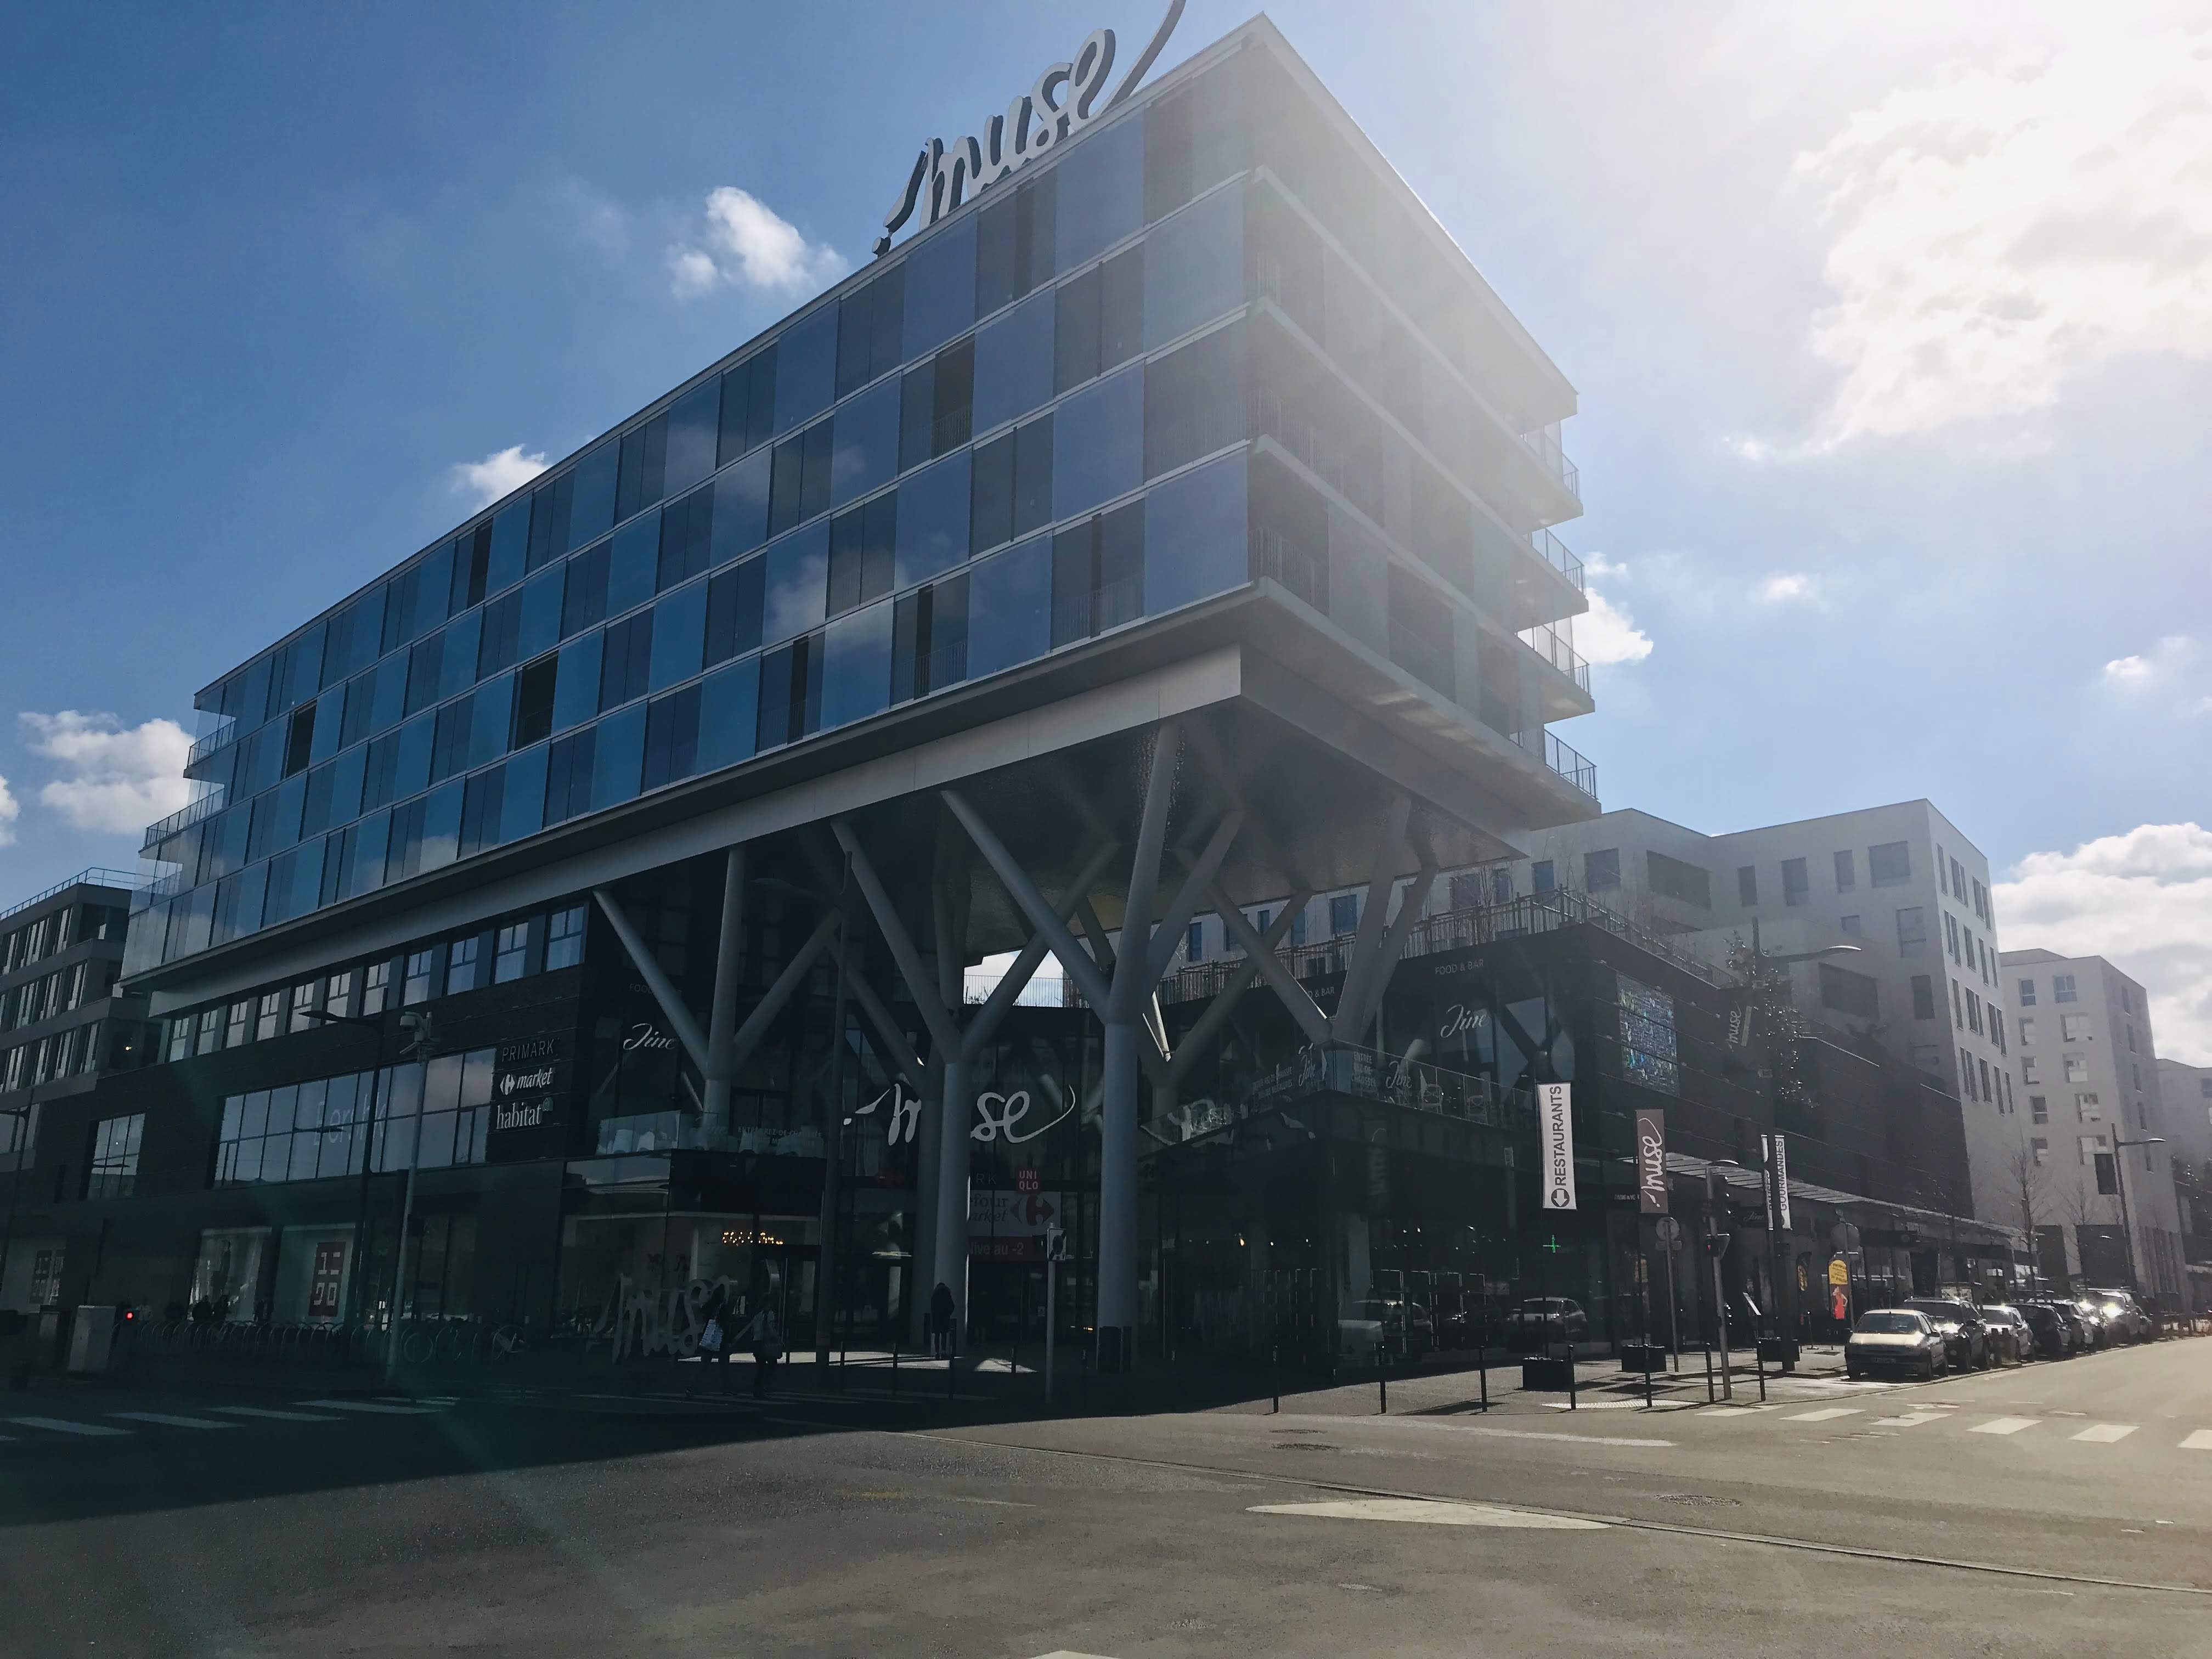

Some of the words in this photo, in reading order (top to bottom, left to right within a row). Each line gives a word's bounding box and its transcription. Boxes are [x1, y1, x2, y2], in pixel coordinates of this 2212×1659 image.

[1435, 964, 1457, 975] FOOD
[1468, 959, 1483, 970] BAR
[1321, 986, 1335, 996] BAR
[502, 1039, 555, 1062] PRIMARK
[517, 1067, 553, 1088] market
[496, 1102, 541, 1130] habitat
[1549, 1086, 1566, 1186] RESTAURANTS
[1638, 1117, 1666, 1207] muse
[1019, 1170, 1037, 1180] UNI
[1776, 1141, 1787, 1211] GOURMANDES
[1019, 1181, 1038, 1192] QLO
